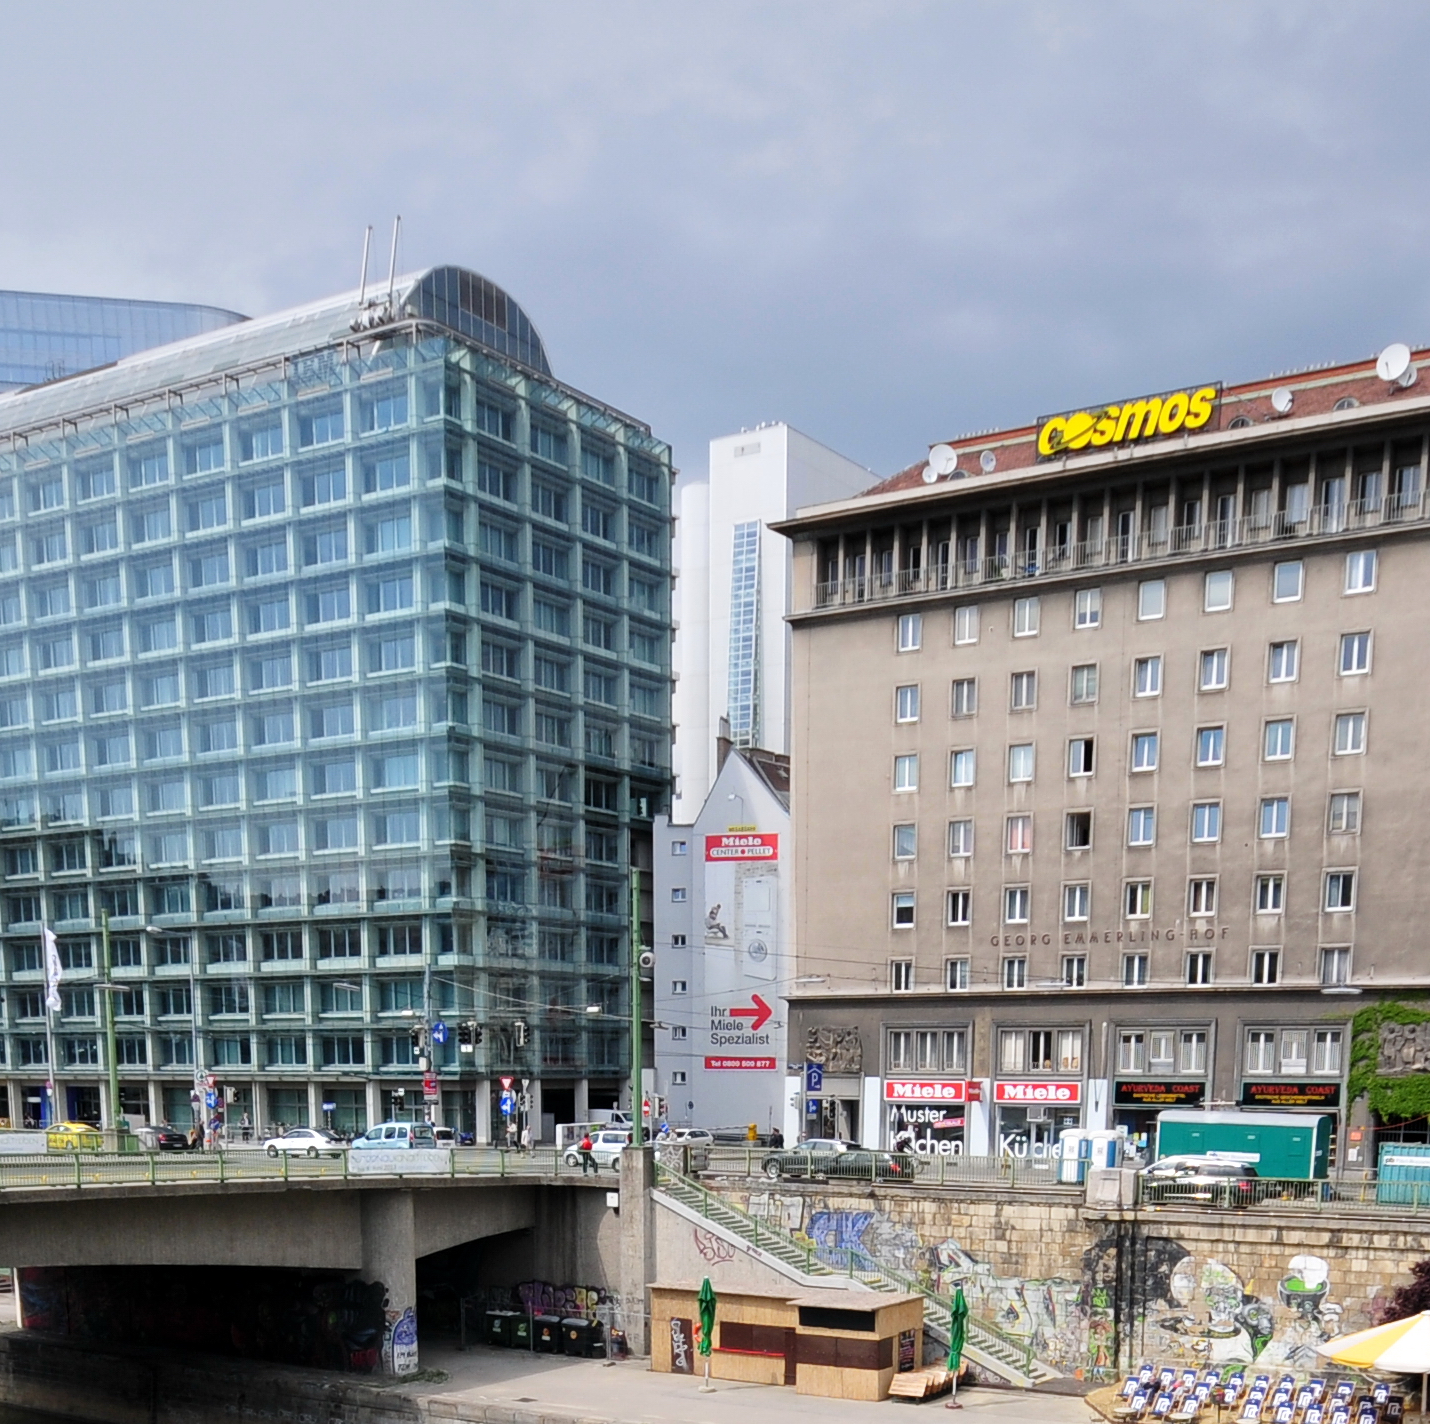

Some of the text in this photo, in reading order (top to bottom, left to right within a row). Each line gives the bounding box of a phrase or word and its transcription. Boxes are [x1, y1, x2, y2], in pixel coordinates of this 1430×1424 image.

[721, 837, 762, 846] Miele
[711, 846, 770, 856] CENTER PELLET
[990, 927, 1230, 947] GEORG EMMERLING-HOF
[710, 1006, 727, 1017] Ihr
[710, 1020, 743, 1031] Miele
[710, 1033, 770, 1047] Spezialist
[893, 1083, 956, 1098] Miele
[1003, 1085, 1071, 1100] Miele
[1121, 1084, 1166, 1092] AYURVEDA
[1250, 1085, 1336, 1094] AYURVEDA COAST
[891, 1105, 947, 1122] Muster
